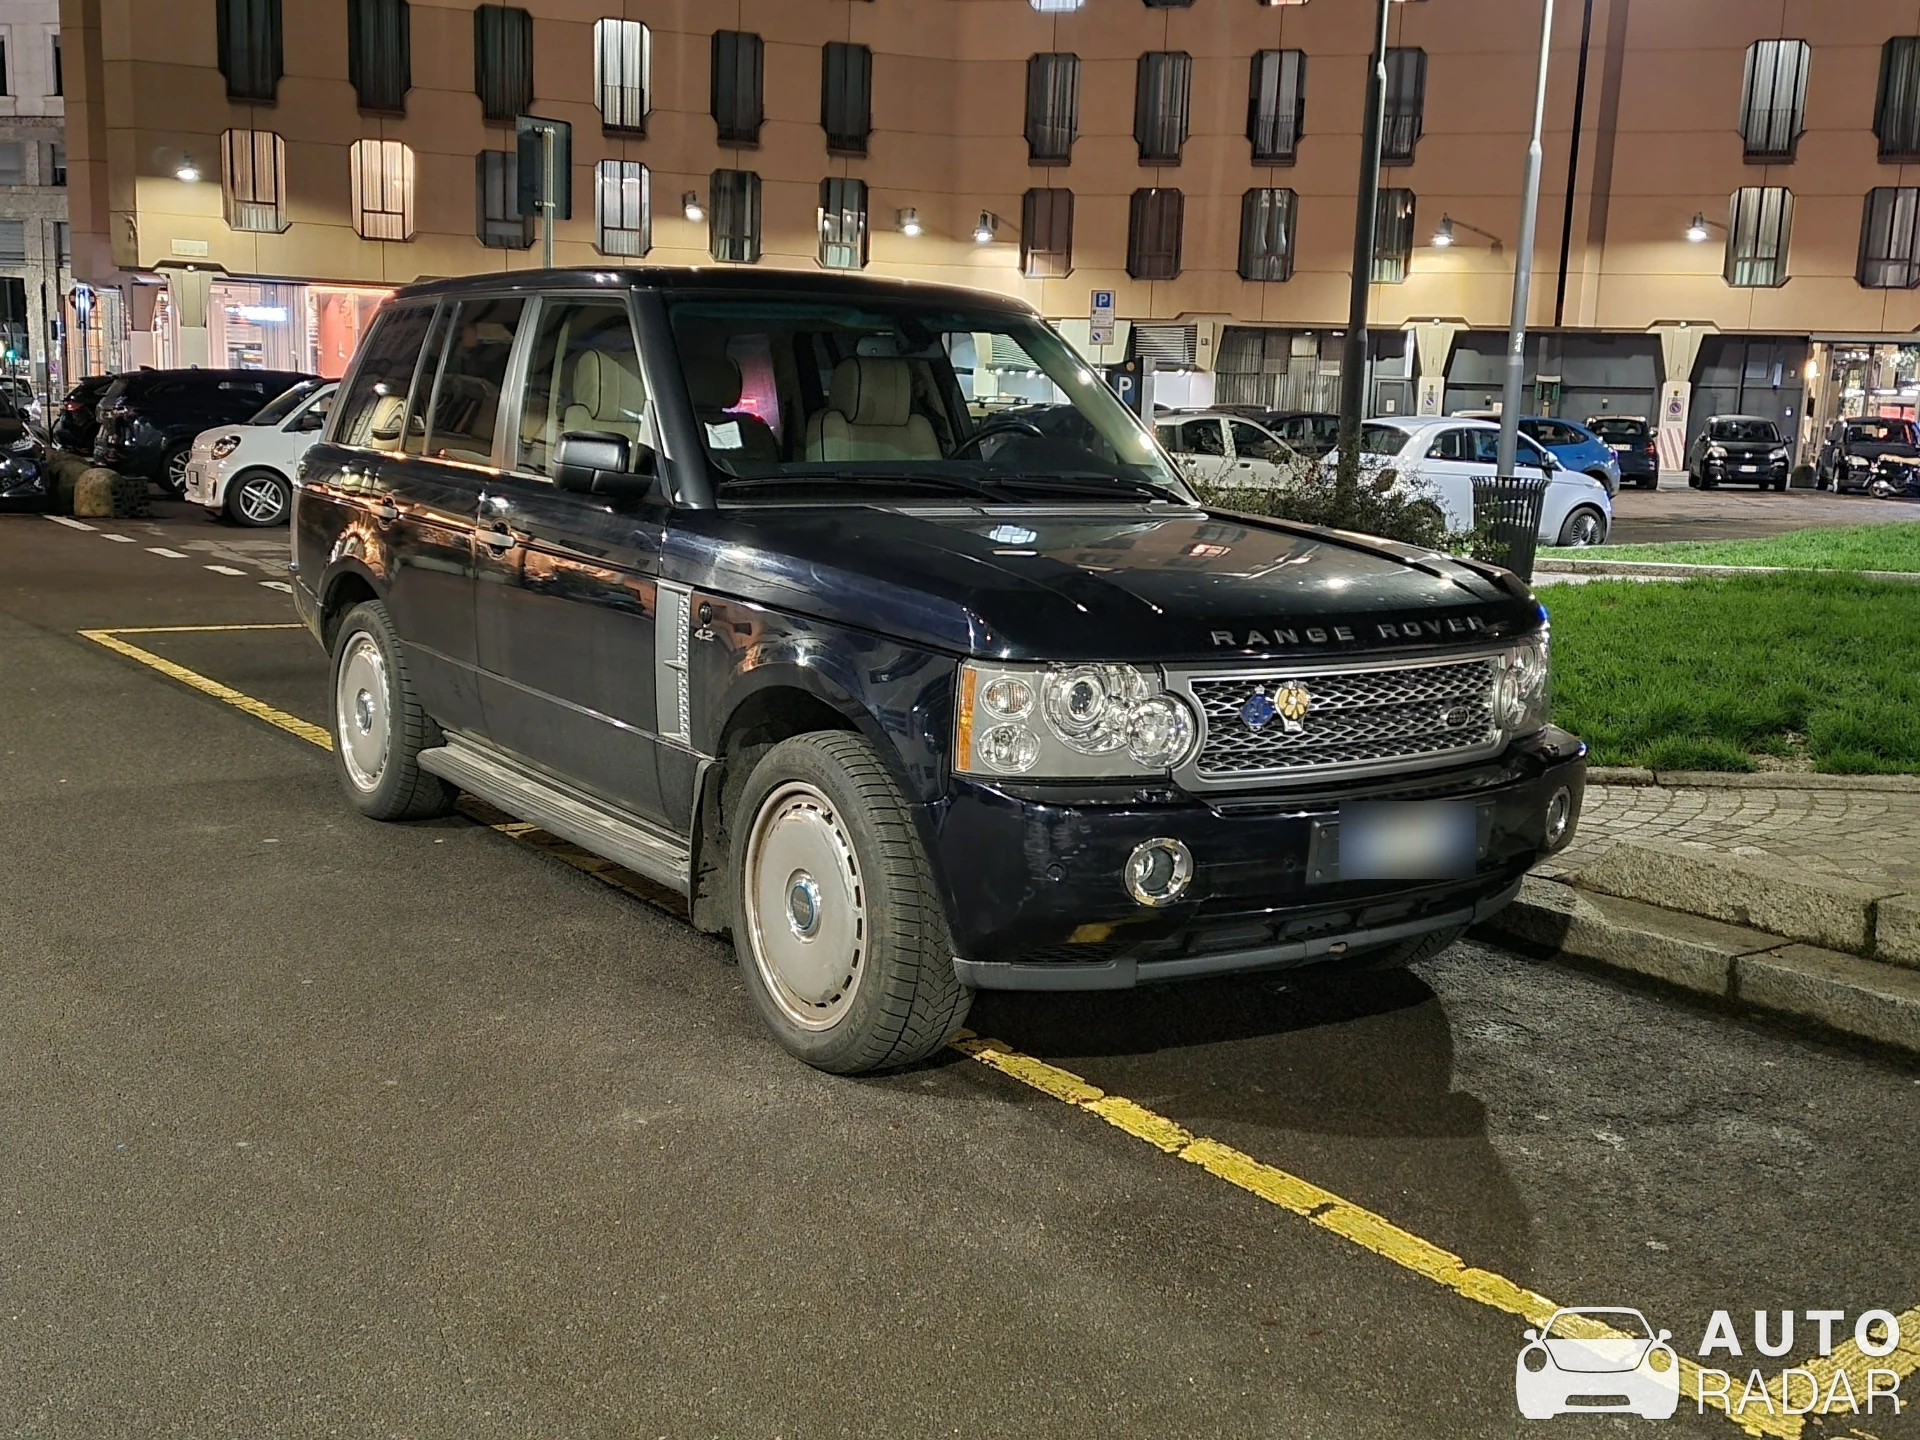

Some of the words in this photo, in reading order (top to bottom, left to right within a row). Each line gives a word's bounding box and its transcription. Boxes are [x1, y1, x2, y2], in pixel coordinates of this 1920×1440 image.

[1098, 293, 1108, 307] P
[1118, 376, 1133, 401] P
[1211, 626, 1356, 646] RANGE
[1377, 615, 1487, 639] ROVER
